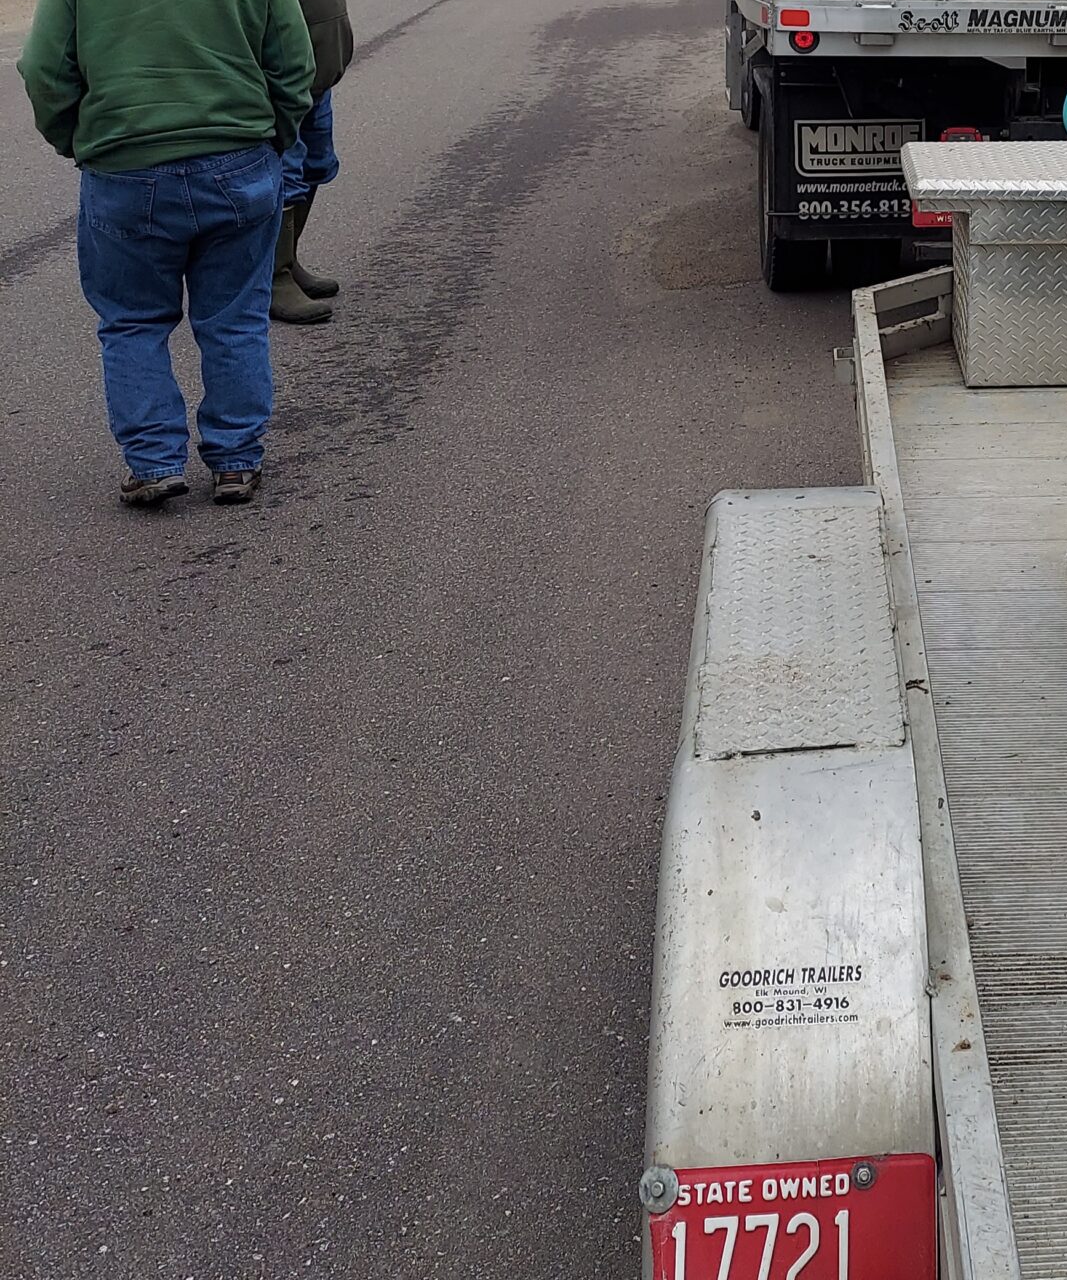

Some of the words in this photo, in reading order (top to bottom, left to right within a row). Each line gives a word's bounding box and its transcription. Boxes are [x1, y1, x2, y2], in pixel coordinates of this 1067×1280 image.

[898, 10, 960, 32] Scott
[810, 157, 846, 166] TRUCK
[851, 156, 901, 166] EQUIPME
[796, 179, 908, 194] www.monroetruck.c
[719, 968, 795, 988] GOODRICH
[801, 965, 862, 984] TRAILERS
[755, 988, 769, 996] Elk
[773, 986, 809, 997] Mound,
[814, 986, 827, 995] WI
[732, 996, 850, 1015] 800-831-4916
[723, 1012, 859, 1029] www.goodrichtrailers.com
[677, 1179, 752, 1206] STATE
[762, 1173, 850, 1201] OWNED
[671, 1209, 850, 1280] 17721
